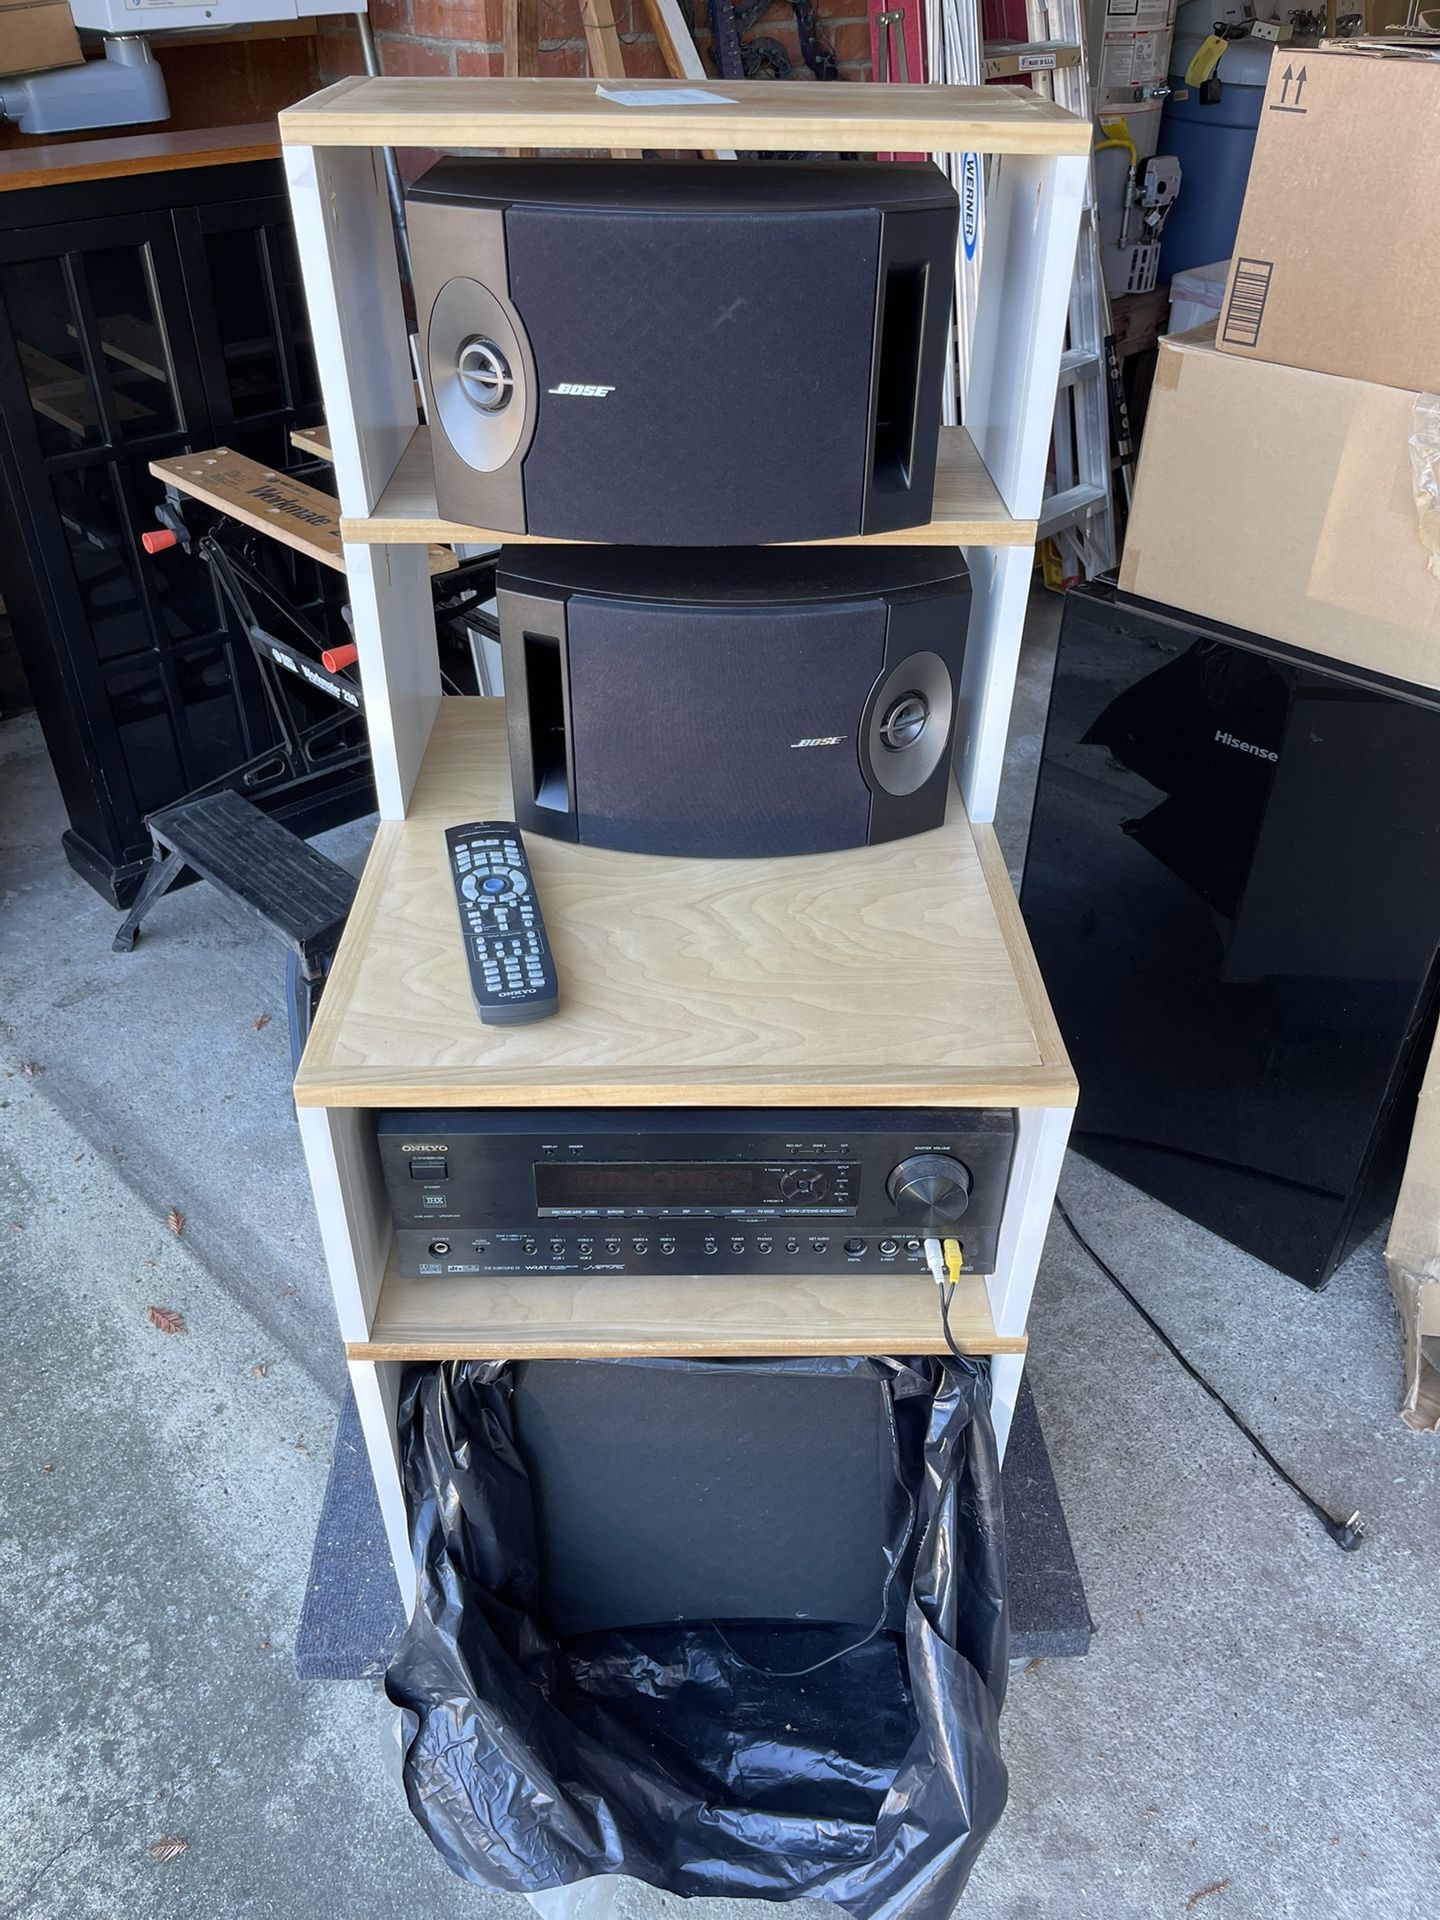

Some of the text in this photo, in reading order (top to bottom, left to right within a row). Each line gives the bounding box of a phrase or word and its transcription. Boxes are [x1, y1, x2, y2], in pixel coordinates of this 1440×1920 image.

[965, 159, 976, 237] WERNER
[548, 382, 616, 398] BOSE
[246, 484, 332, 527] Workmate
[790, 735, 849, 748] BOSE
[1214, 729, 1279, 762] Hisense
[498, 988, 538, 998] ONKYO
[425, 1197, 445, 1205] THX
